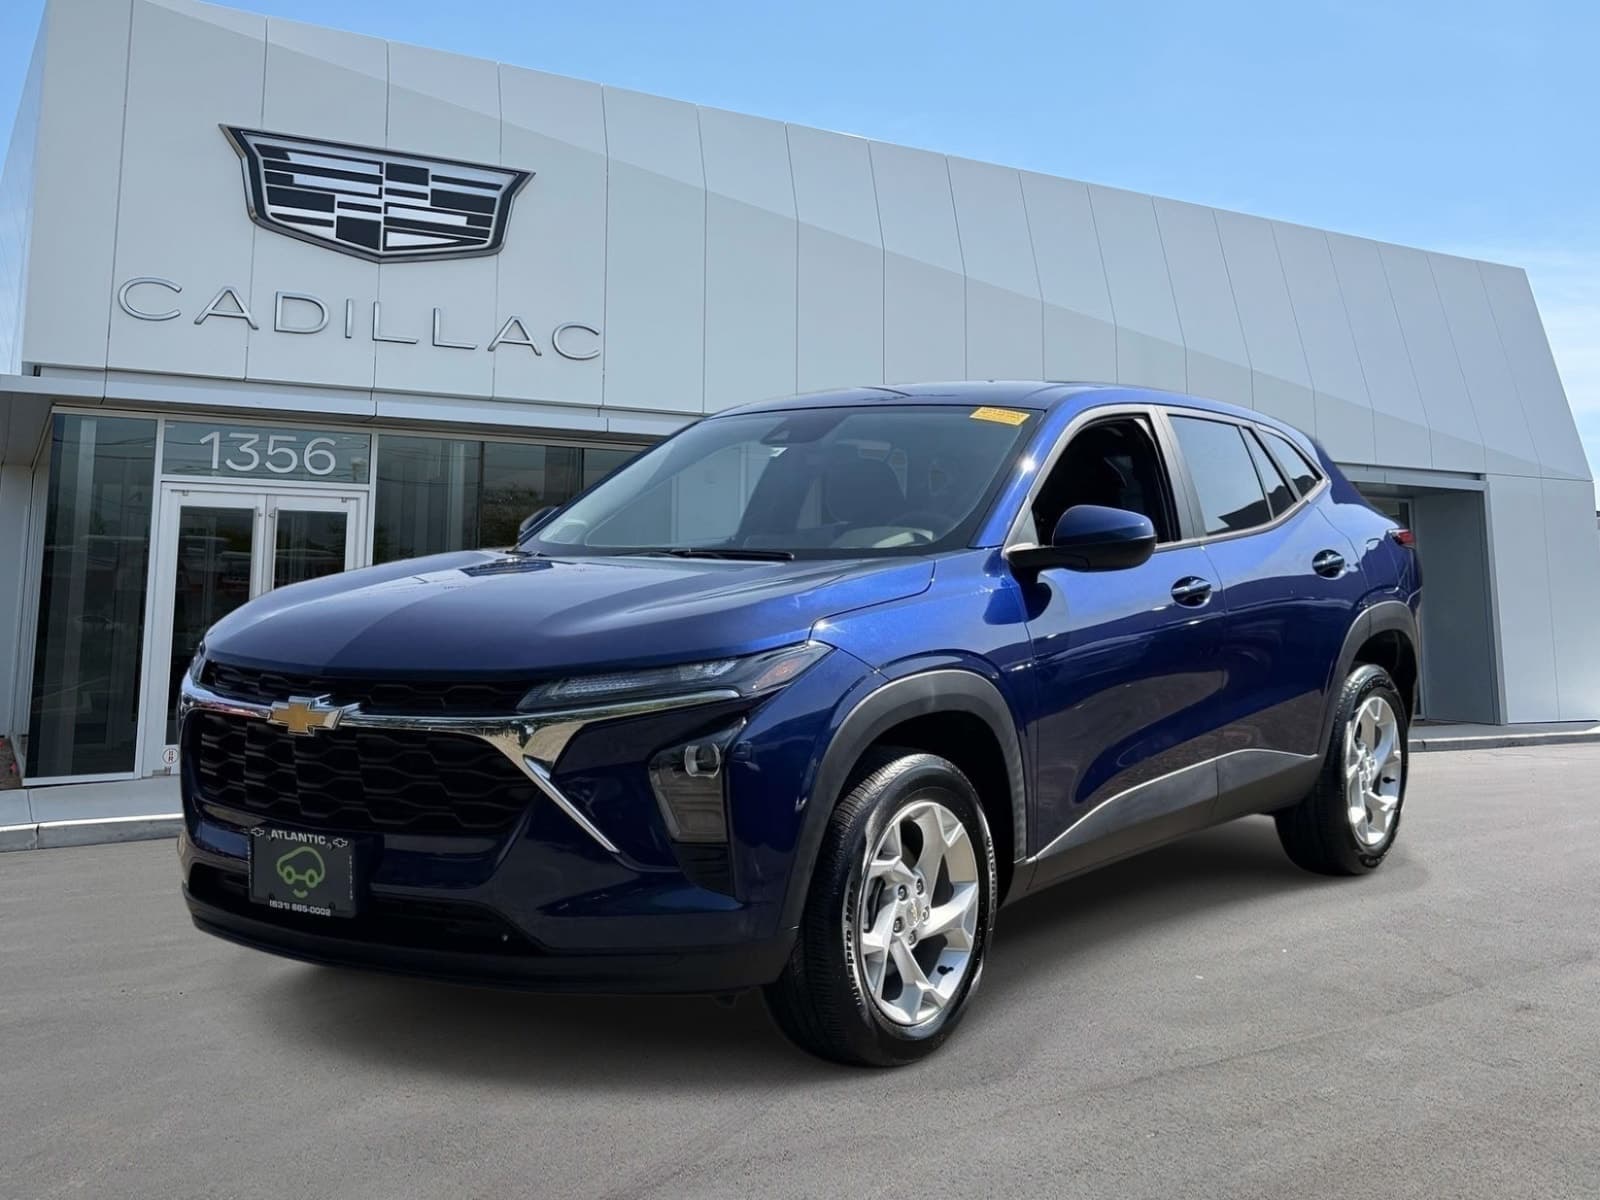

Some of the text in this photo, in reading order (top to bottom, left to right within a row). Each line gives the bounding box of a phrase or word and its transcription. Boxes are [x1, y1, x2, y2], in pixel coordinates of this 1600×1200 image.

[117, 275, 601, 361] CADILLAC
[199, 430, 337, 476] 1356
[270, 829, 327, 846] ATLANTIC
